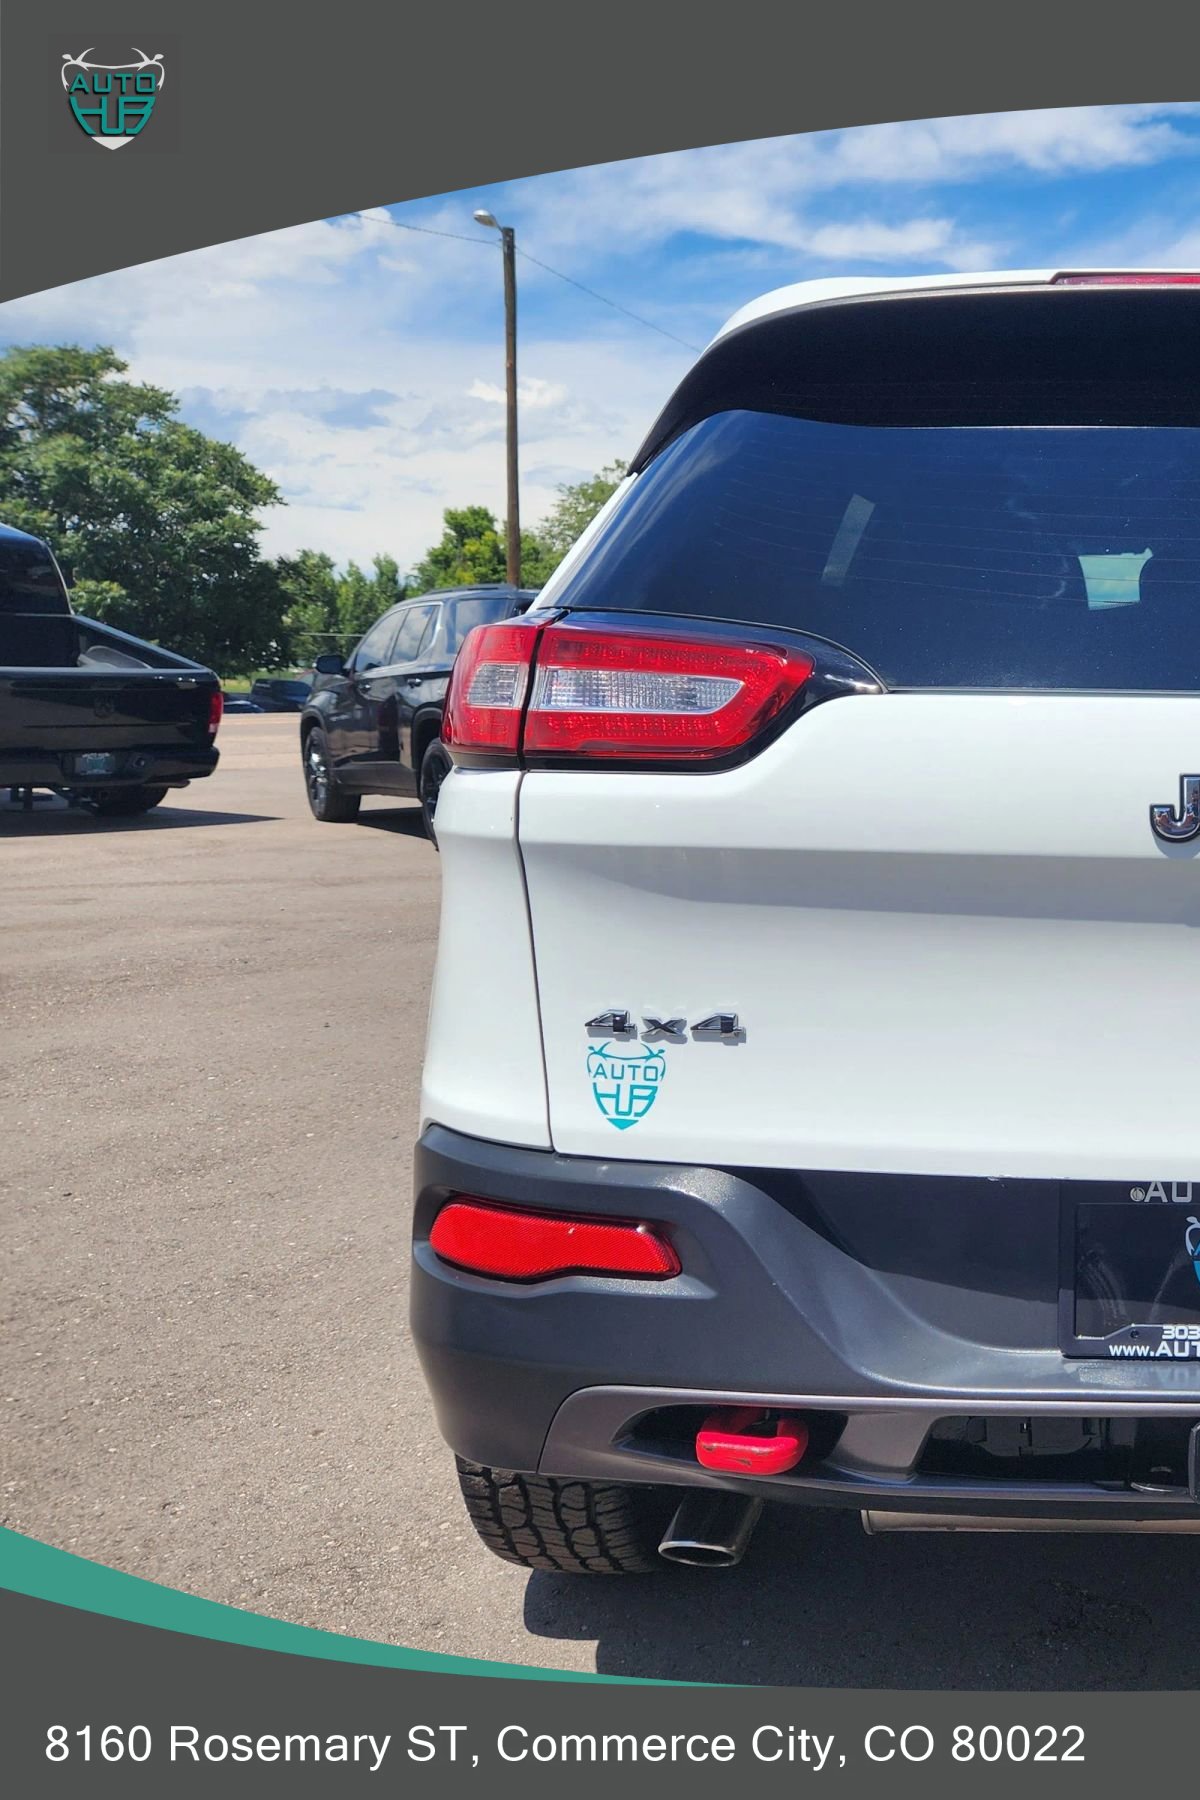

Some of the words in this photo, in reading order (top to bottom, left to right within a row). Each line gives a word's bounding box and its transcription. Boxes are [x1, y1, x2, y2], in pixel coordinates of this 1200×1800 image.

[585, 1008, 746, 1039] 4x4
[593, 1062, 659, 1082] AUTO
[592, 1082, 659, 1117] HUB
